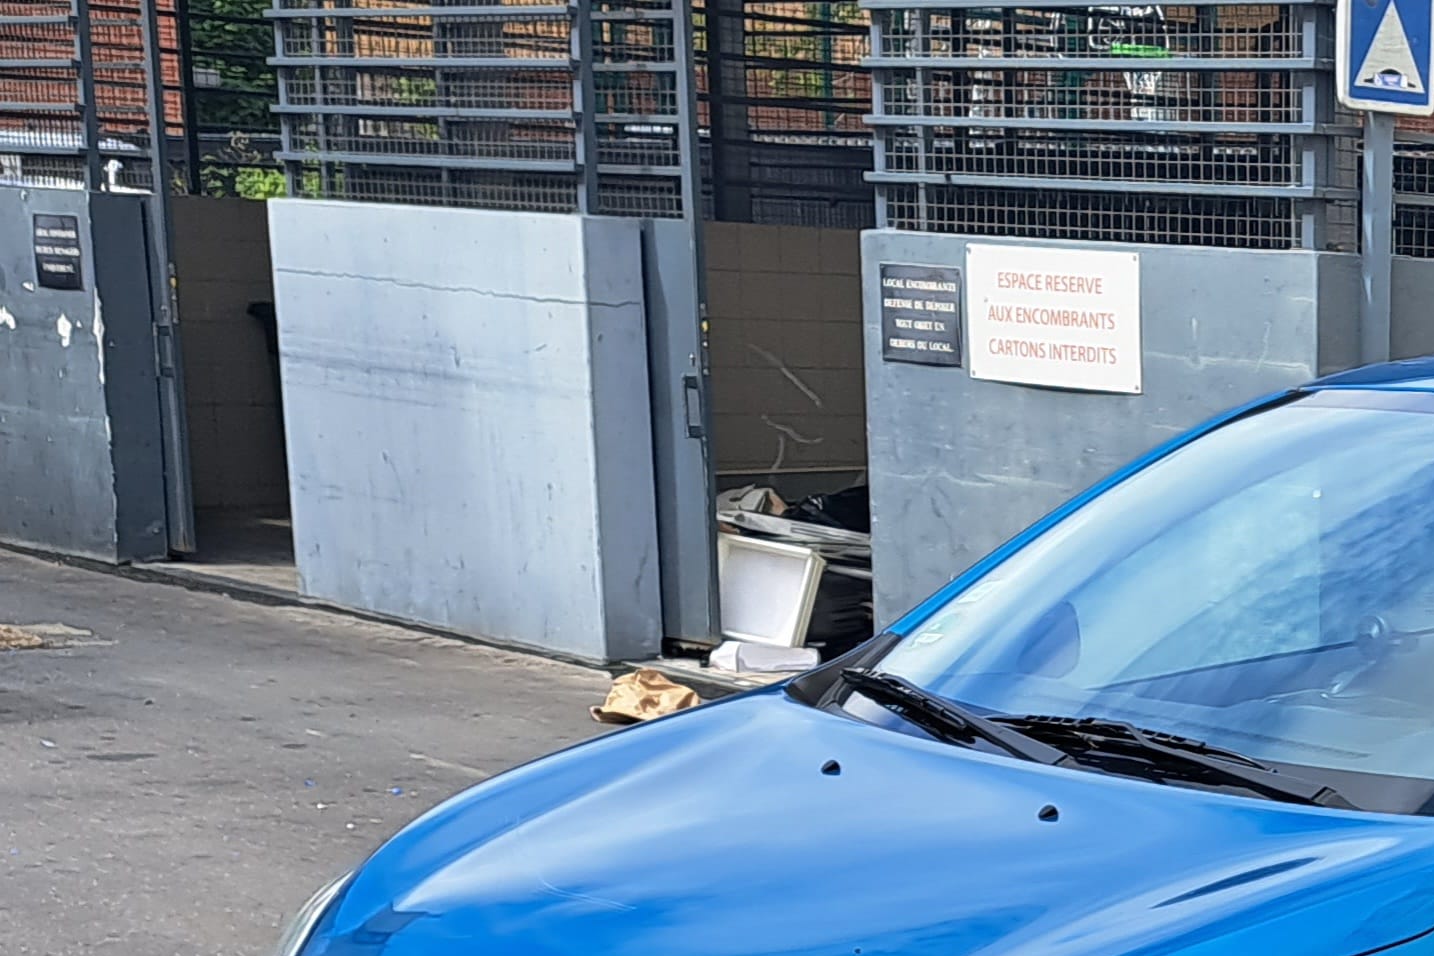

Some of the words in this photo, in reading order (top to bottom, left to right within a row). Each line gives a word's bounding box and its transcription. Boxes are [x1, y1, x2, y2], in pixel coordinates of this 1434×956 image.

[997, 271, 1043, 291] ESPACE
[1045, 274, 1103, 295] RESERVE
[988, 304, 1013, 322] AUX
[1016, 306, 1115, 330] ENCOMBRANTS
[988, 337, 1046, 359] CARTONS
[1048, 343, 1117, 365] INTERDITS
